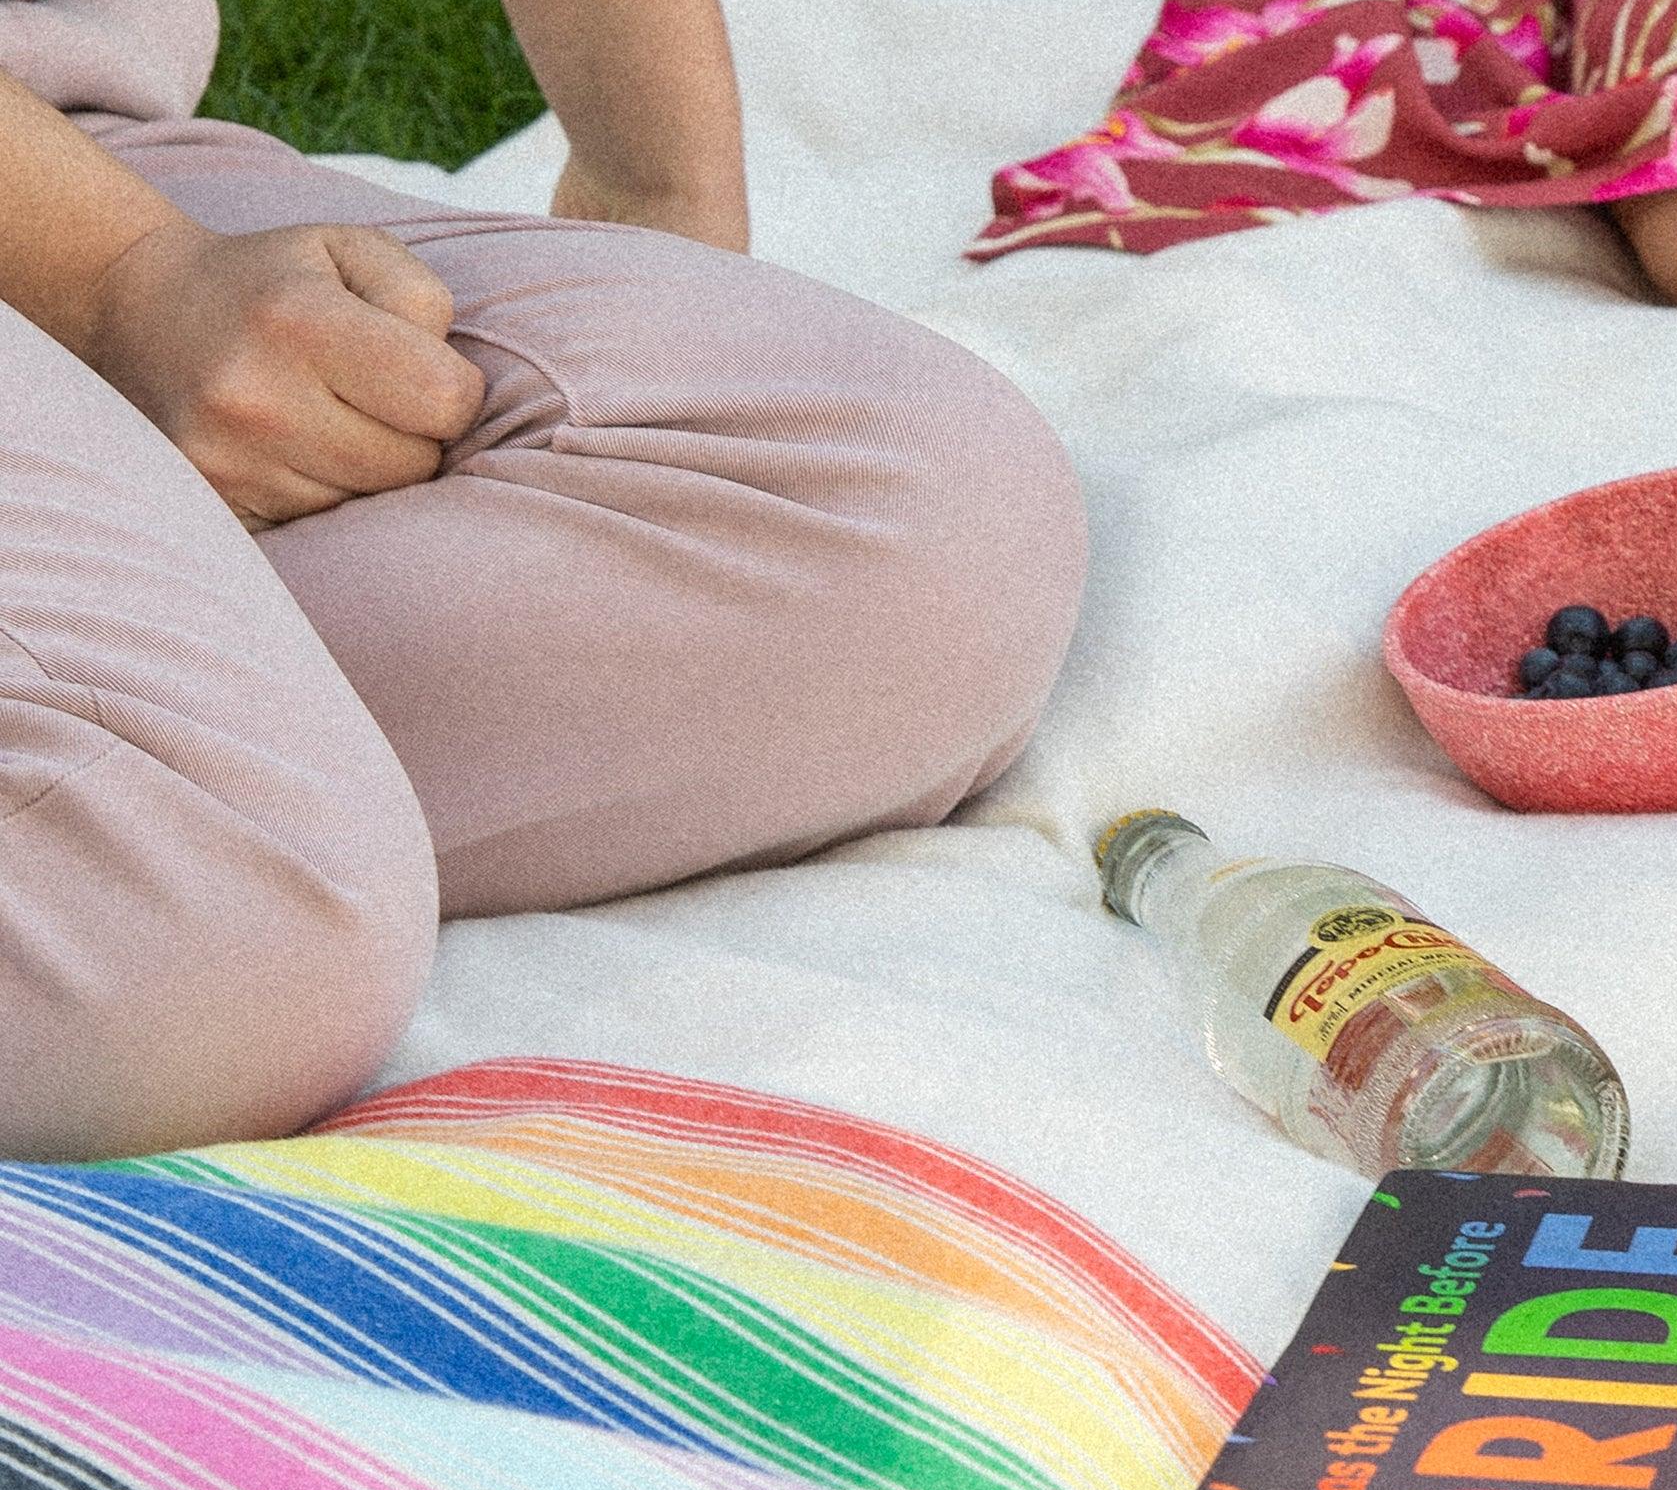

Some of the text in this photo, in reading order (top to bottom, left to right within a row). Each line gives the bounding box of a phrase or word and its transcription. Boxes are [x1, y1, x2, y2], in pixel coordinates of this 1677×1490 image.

[1289, 945, 1382, 1023] Topo
[1348, 958, 1414, 1000] MINERAL
[1400, 1220, 1506, 1315] Before
[1352, 1322, 1459, 1401] Night
[1324, 1406, 1409, 1456] the
